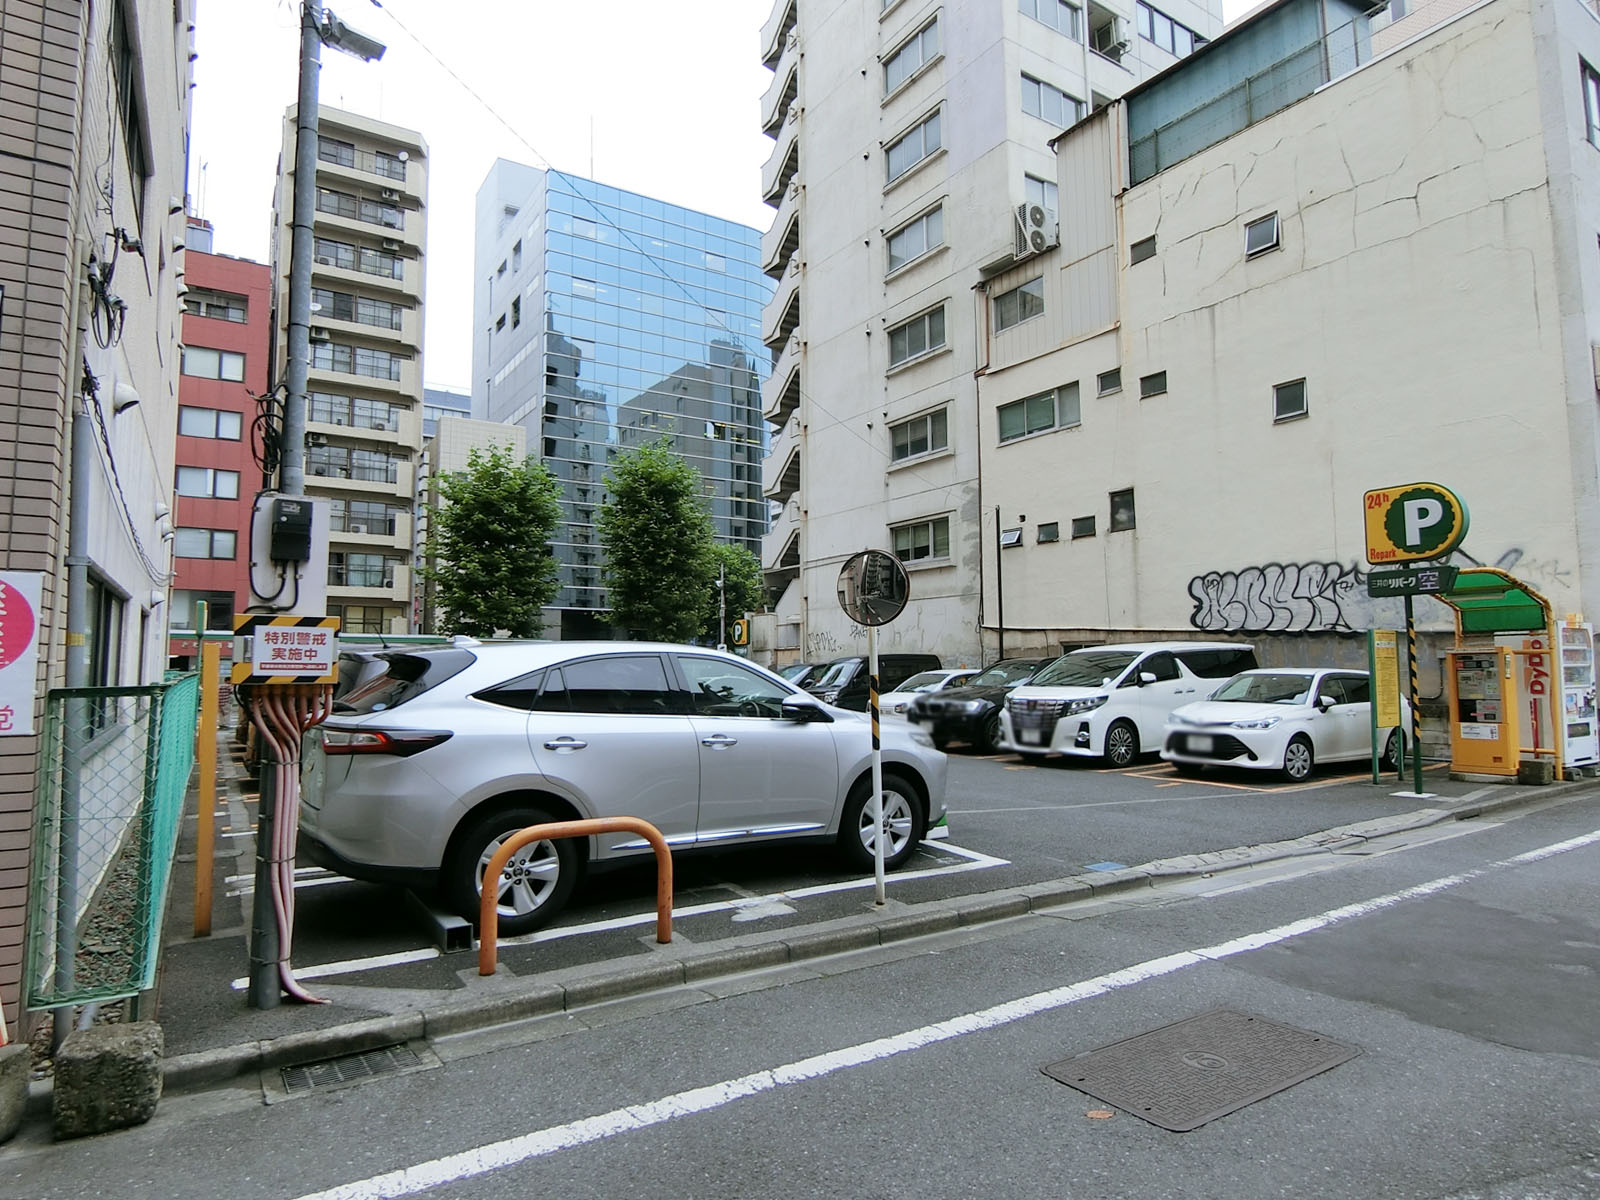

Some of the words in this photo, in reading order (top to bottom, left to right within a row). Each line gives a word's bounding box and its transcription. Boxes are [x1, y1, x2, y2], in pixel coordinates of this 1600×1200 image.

[1403, 498, 1443, 546] P
[1370, 548, 1397, 560] Repark
[1418, 571, 1440, 590] 空
[264, 631, 327, 646] 特別警戒
[734, 624, 742, 641] P
[271, 647, 318, 661] 実施中
[1528, 639, 1549, 695] DyDo
